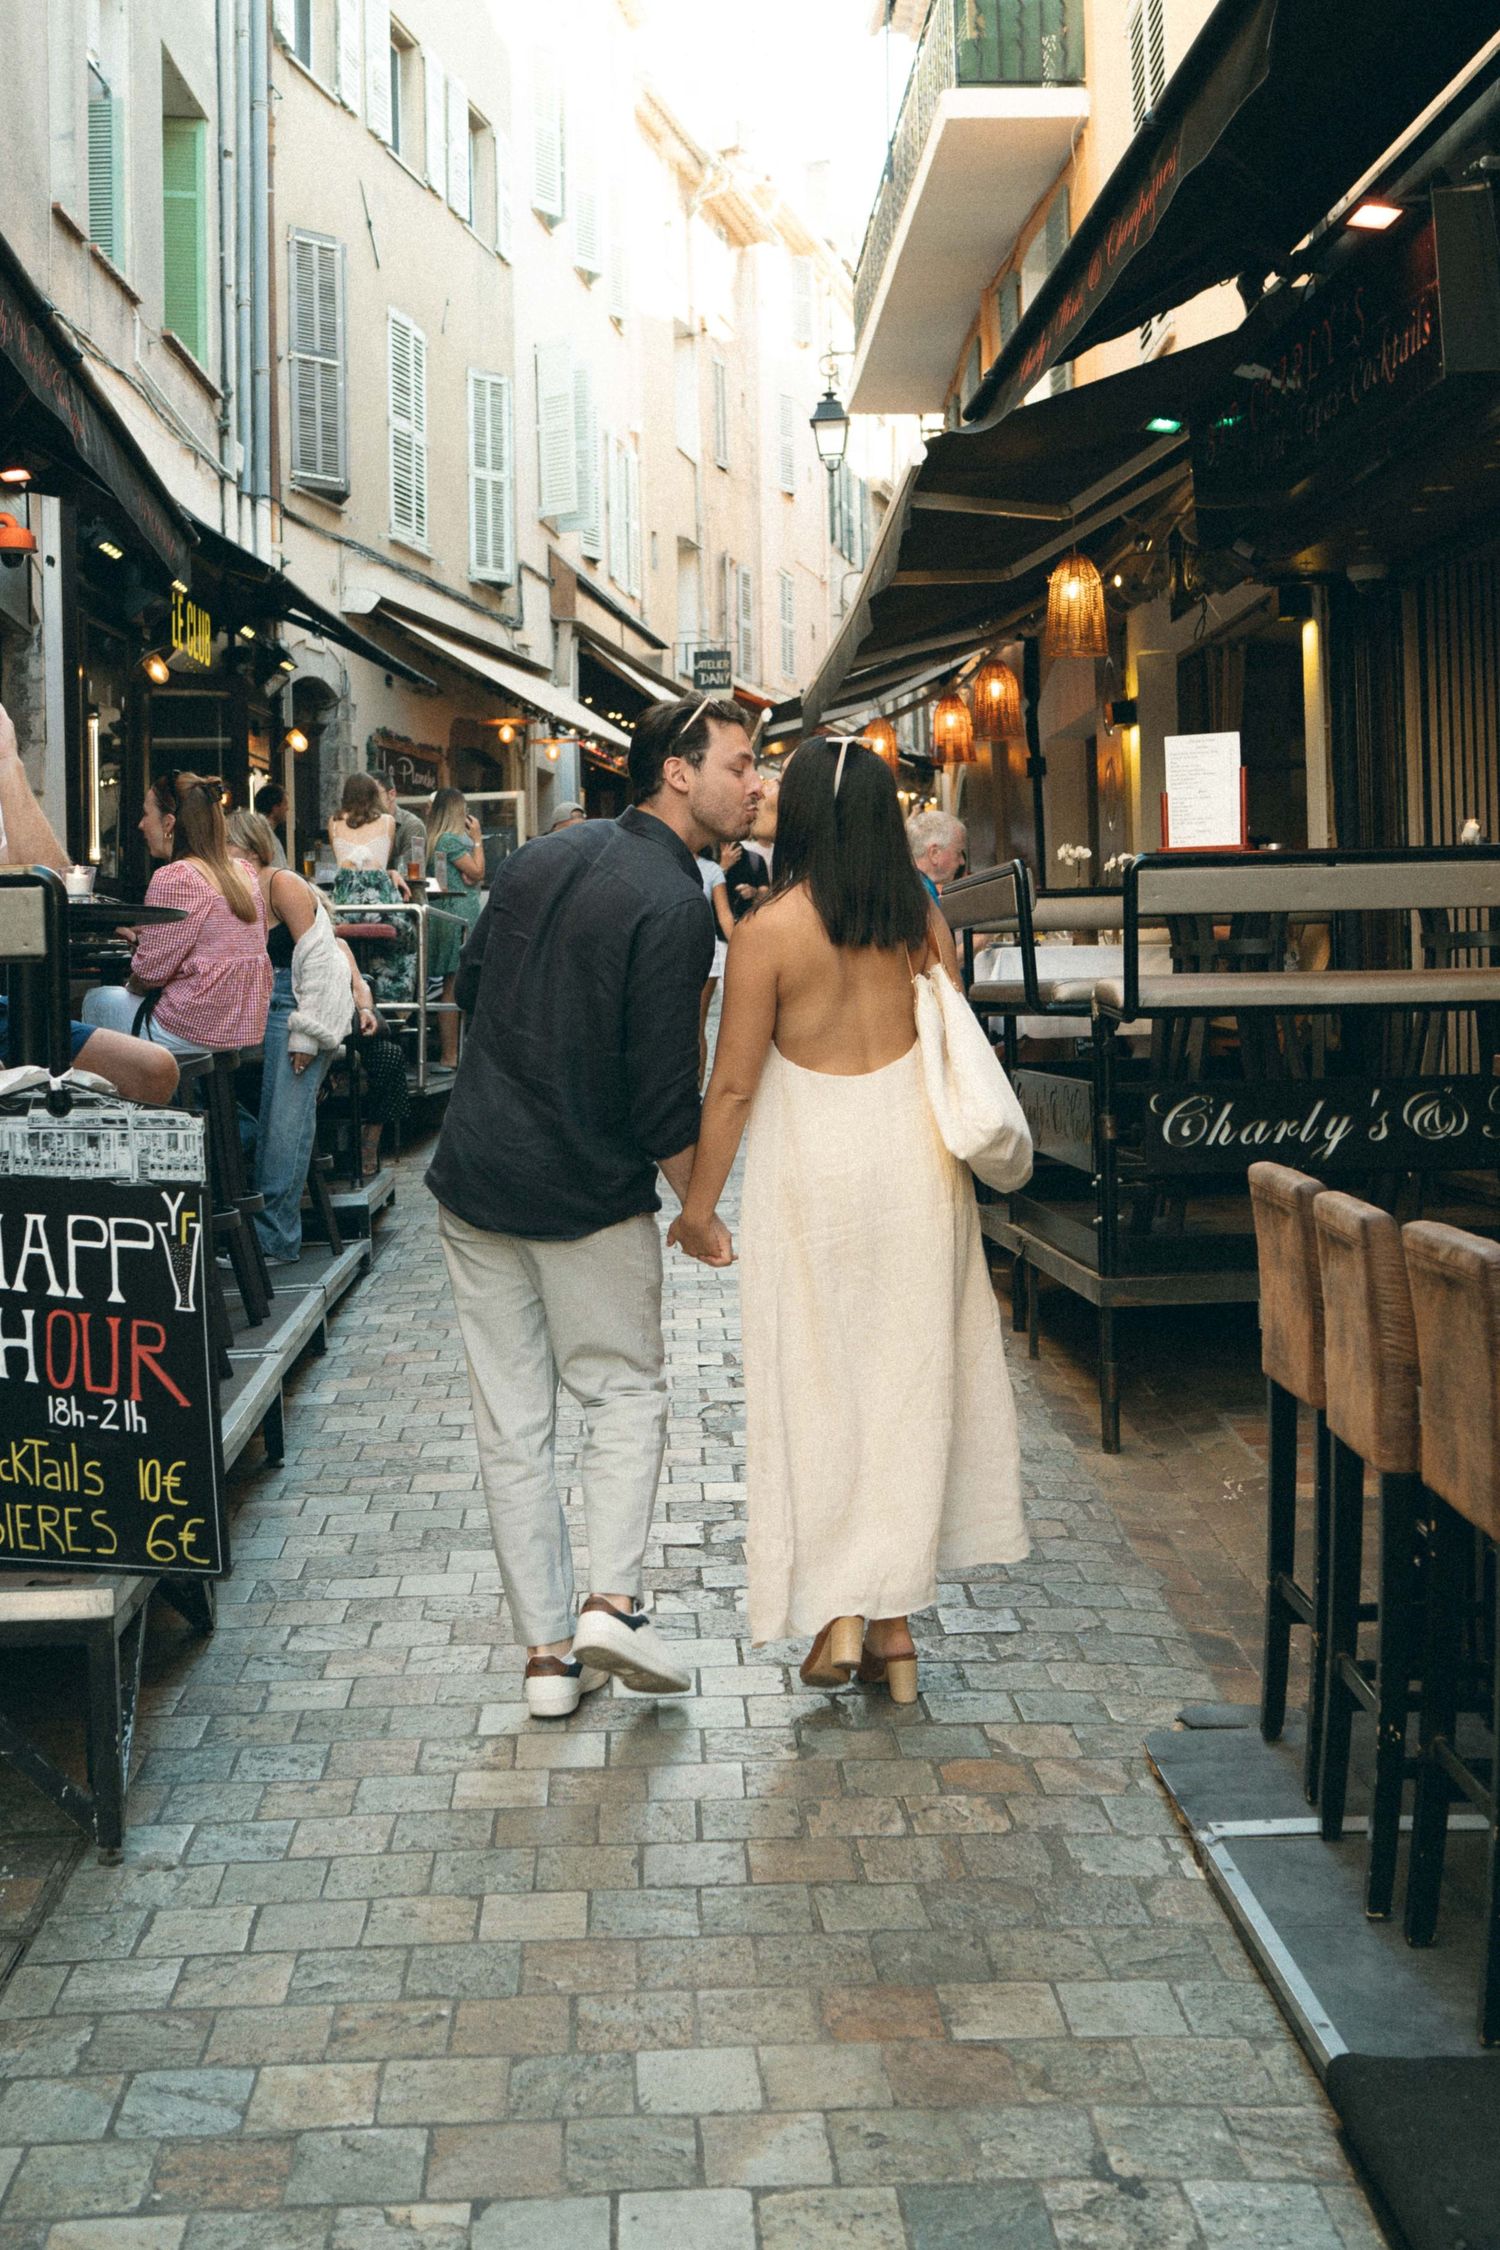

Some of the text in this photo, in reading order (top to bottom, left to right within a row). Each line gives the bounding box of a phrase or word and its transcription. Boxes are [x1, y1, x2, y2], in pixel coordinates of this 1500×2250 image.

[172, 591, 211, 668] LE CLUB
[694, 659, 730, 670] ATELIER
[1150, 1088, 1390, 1160] Charly's
[48, 1395, 147, 1434] 18h-21h
[138, 1458, 189, 1506] 10€
[0, 1502, 211, 1565] IERES 6€
